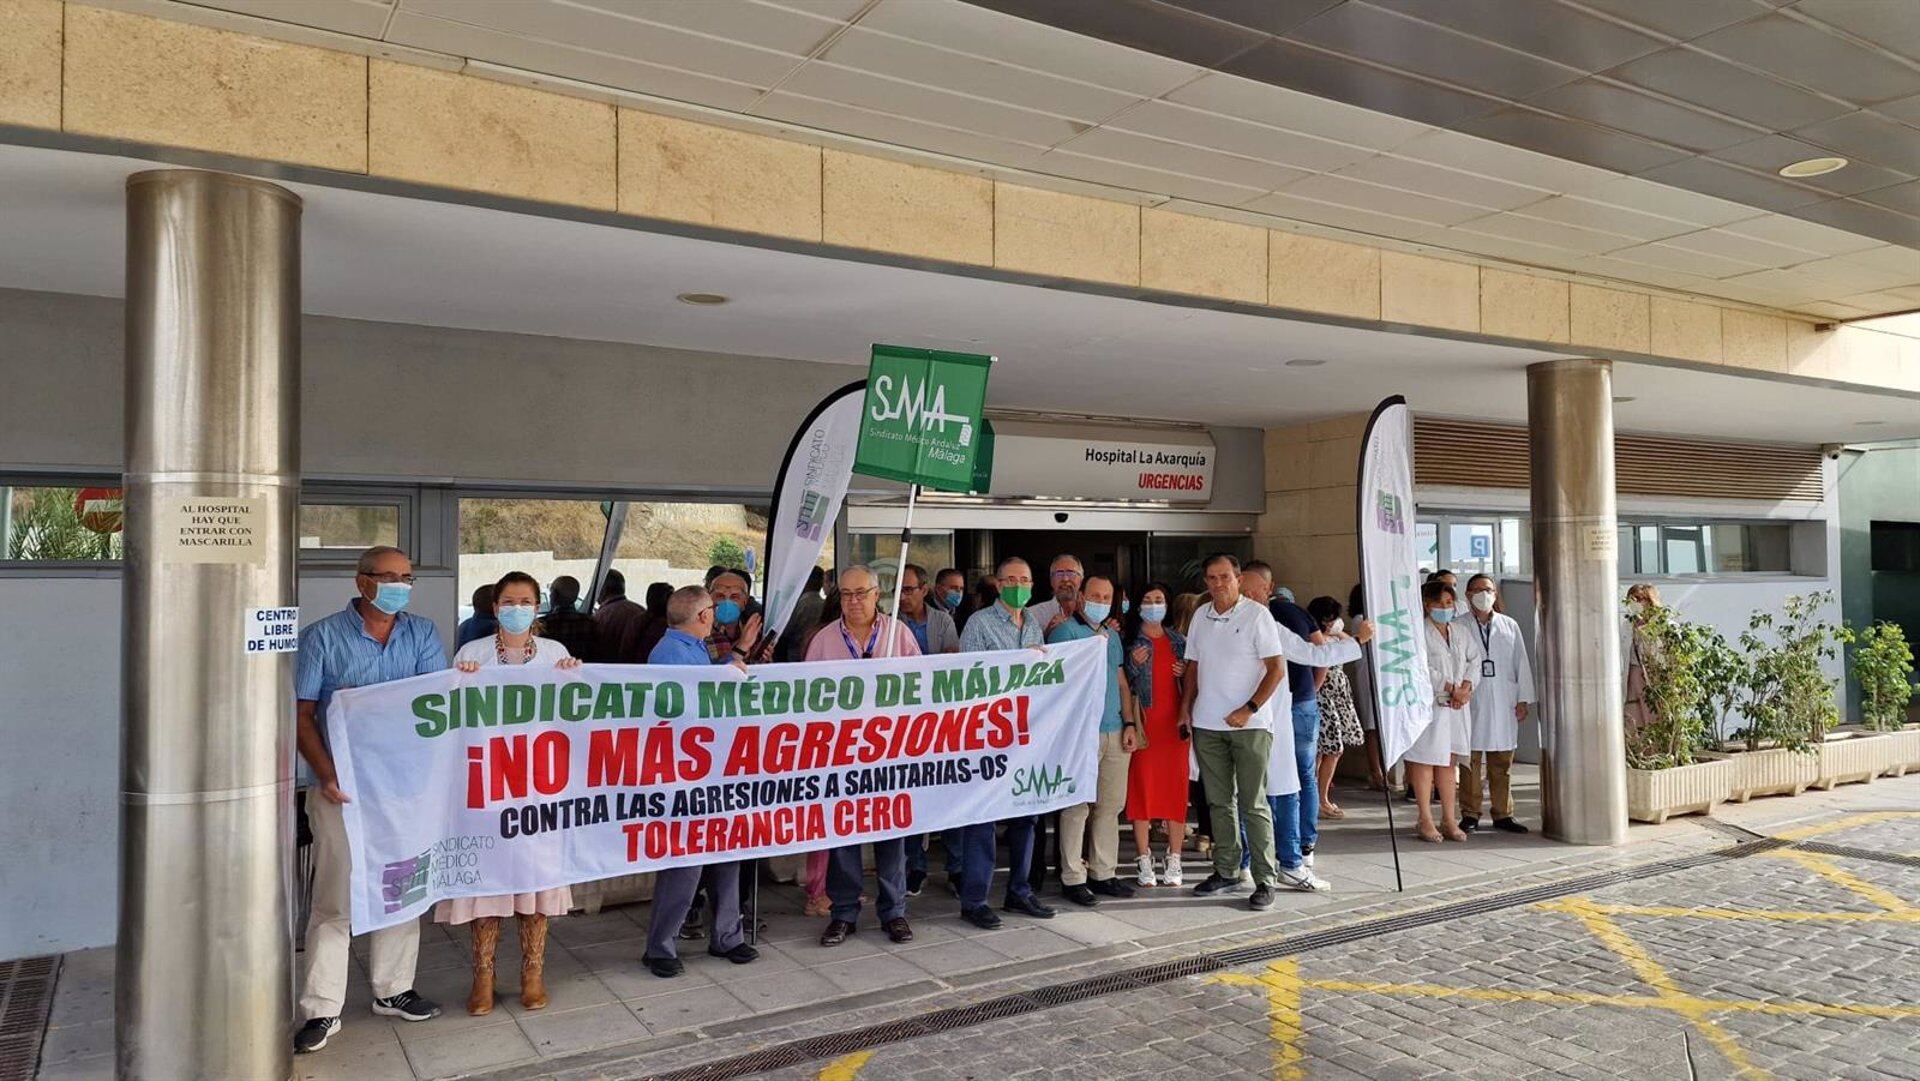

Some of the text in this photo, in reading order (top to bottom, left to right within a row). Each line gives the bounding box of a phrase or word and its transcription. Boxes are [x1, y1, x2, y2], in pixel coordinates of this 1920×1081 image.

[872, 374, 969, 432] SMA
[870, 428, 903, 441] Sindicato
[928, 446, 966, 465] Málaga
[1085, 448, 1206, 468] Hospital La Axarquía
[1138, 473, 1204, 491] URGENCIAS
[180, 505, 251, 514] AL HOSPITAL
[192, 516, 241, 525] HAY QUE
[180, 527, 252, 535] ENTRAR CON
[178, 538, 252, 546] MASCARILLA
[256, 609, 297, 622] CENTRO
[264, 624, 293, 636] LIBRE
[247, 639, 265, 651] DE
[411, 658, 1065, 738] SINDICATO MÉDICO DE MÁLAGA
[466, 695, 1030, 810] ¡NO MÁS AGRESIONES!
[500, 753, 1008, 839] CONTRA LAS AGRESIONES A SANITARIAS-OS
[622, 793, 914, 863] TOLERANCIA CERO
